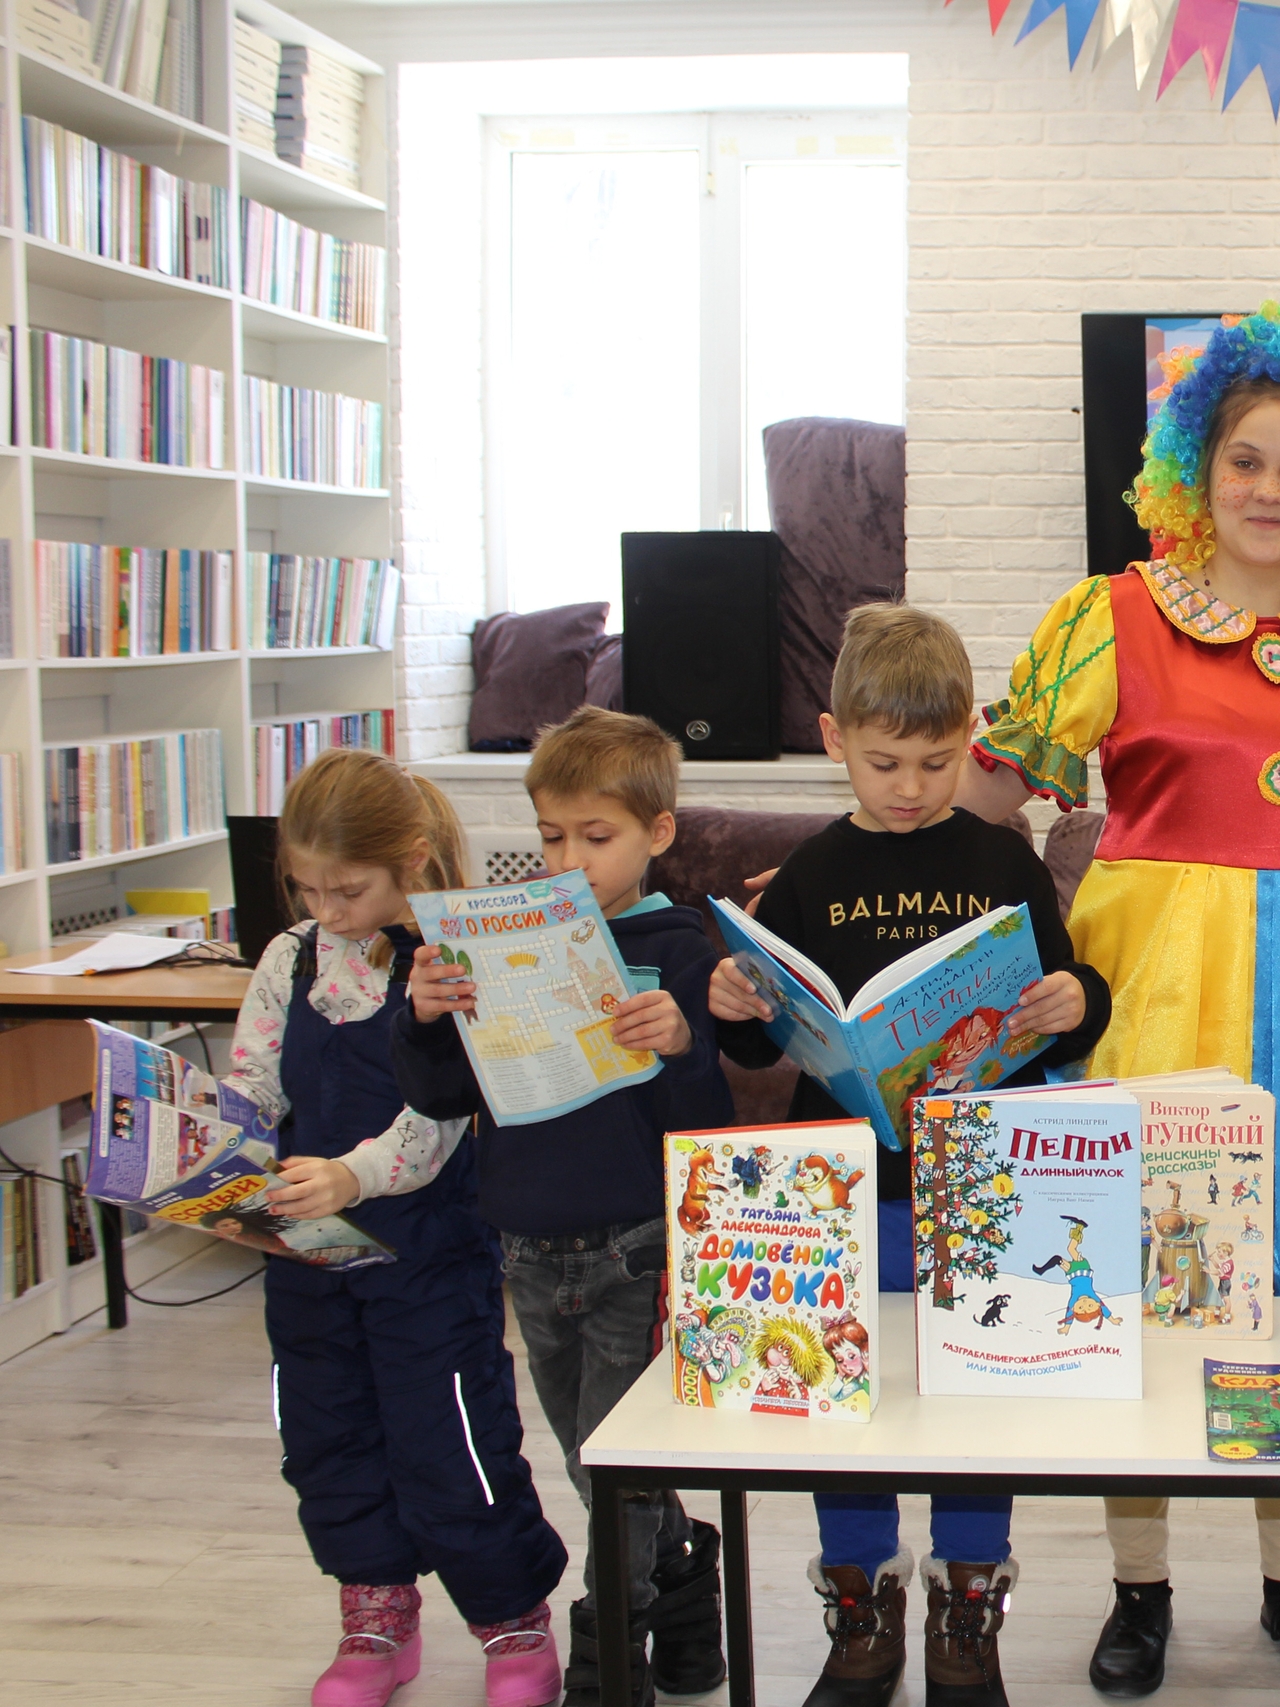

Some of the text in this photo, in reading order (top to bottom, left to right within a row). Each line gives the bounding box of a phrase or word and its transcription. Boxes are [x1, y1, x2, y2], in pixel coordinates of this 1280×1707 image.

[467, 893, 528, 911] КРОССВОРД
[828, 891, 990, 926] BALMAIN
[465, 909, 547, 936] О РОССИИ
[877, 925, 938, 939] PARIS
[1149, 1101, 1210, 1120] Виктор
[1032, 1118, 1108, 1126] АСТРИД ЛИНДГРЕН
[1008, 1127, 1134, 1163] ПЕППИ
[1020, 1167, 1125, 1178] ДЛИННЫЙЧУЛОК
[1148, 1160, 1217, 1178] рассказы
[740, 1207, 800, 1223] ТАТЬЯНА
[721, 1221, 821, 1239] АЛЕКСАНДРОВА
[697, 1233, 844, 1268] ДОМОВЁНОК
[697, 1261, 845, 1310] КУЗЬКА
[966, 1361, 1082, 1377] ИЛИ ХВАТАЙЧТОХОЧЕШЬ!
